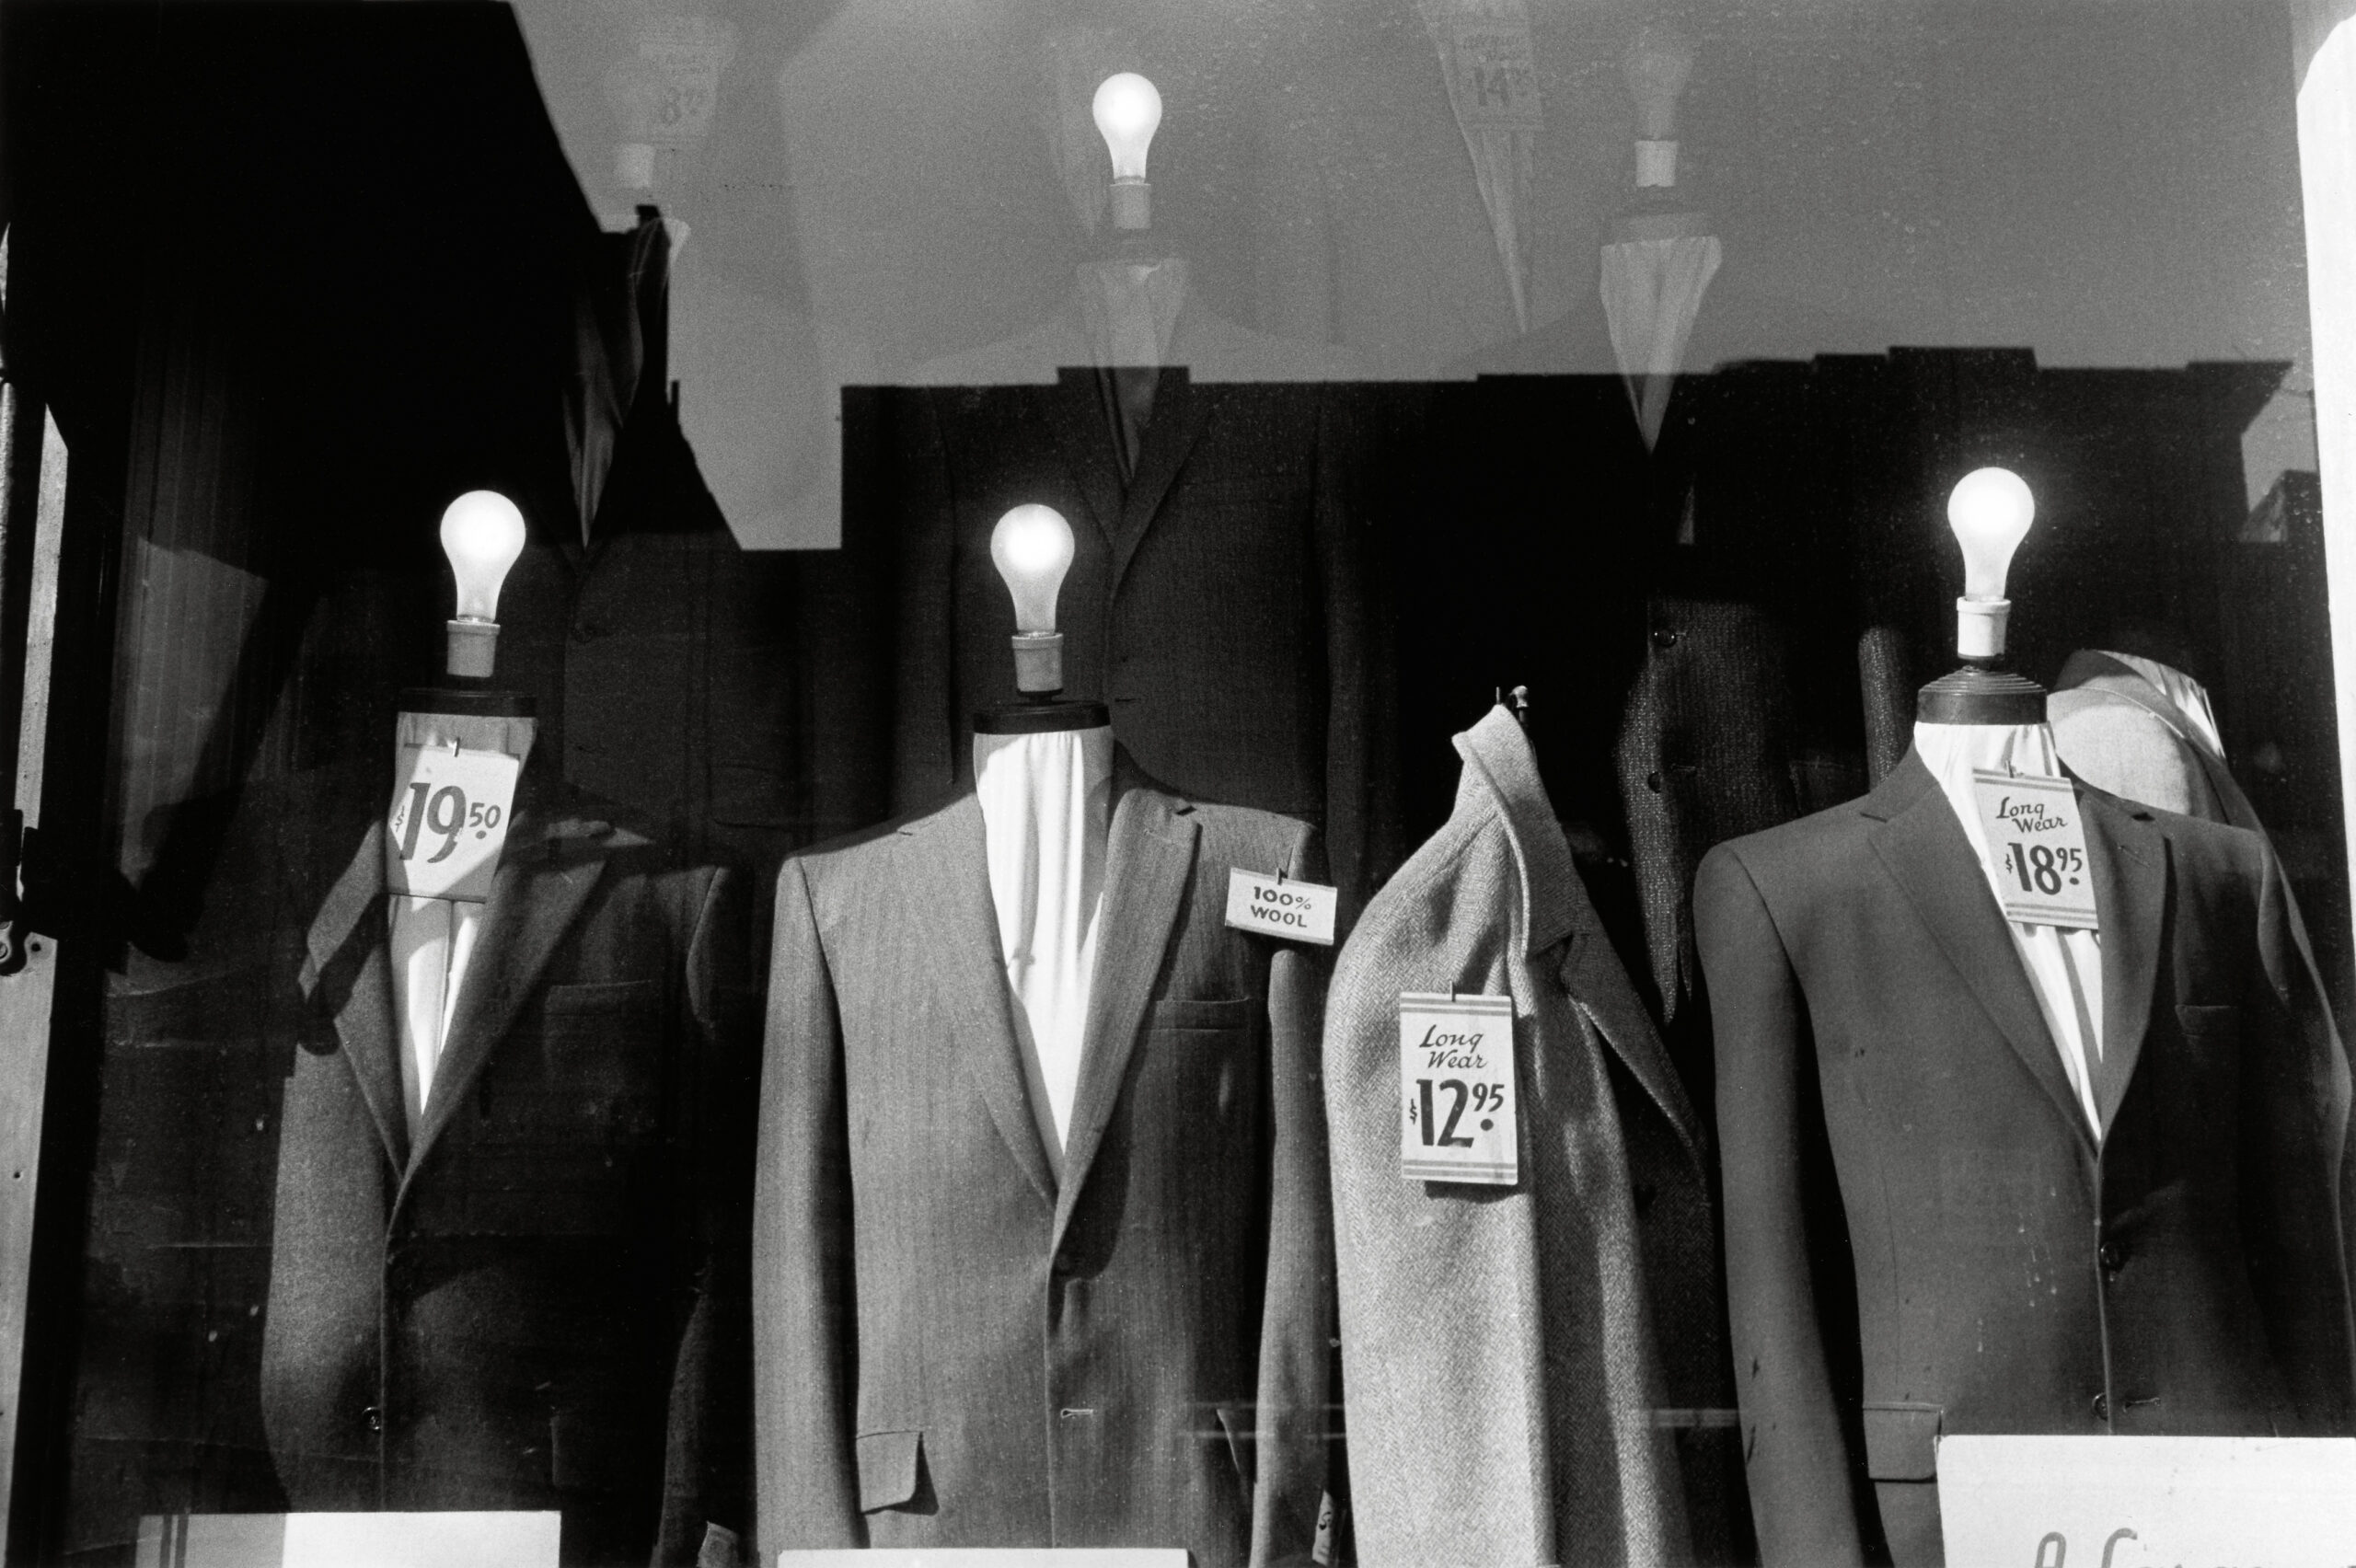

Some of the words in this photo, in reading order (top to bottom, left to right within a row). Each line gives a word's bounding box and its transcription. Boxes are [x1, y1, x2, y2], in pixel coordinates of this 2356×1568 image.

[1996, 796, 2045, 820] Long
[2012, 816, 2068, 833] Wear
[1253, 886, 1311, 910] 100%
[1250, 905, 1308, 928] WOOL
[1419, 1024, 1484, 1053] Long
[1427, 1049, 1488, 1069] Wear
